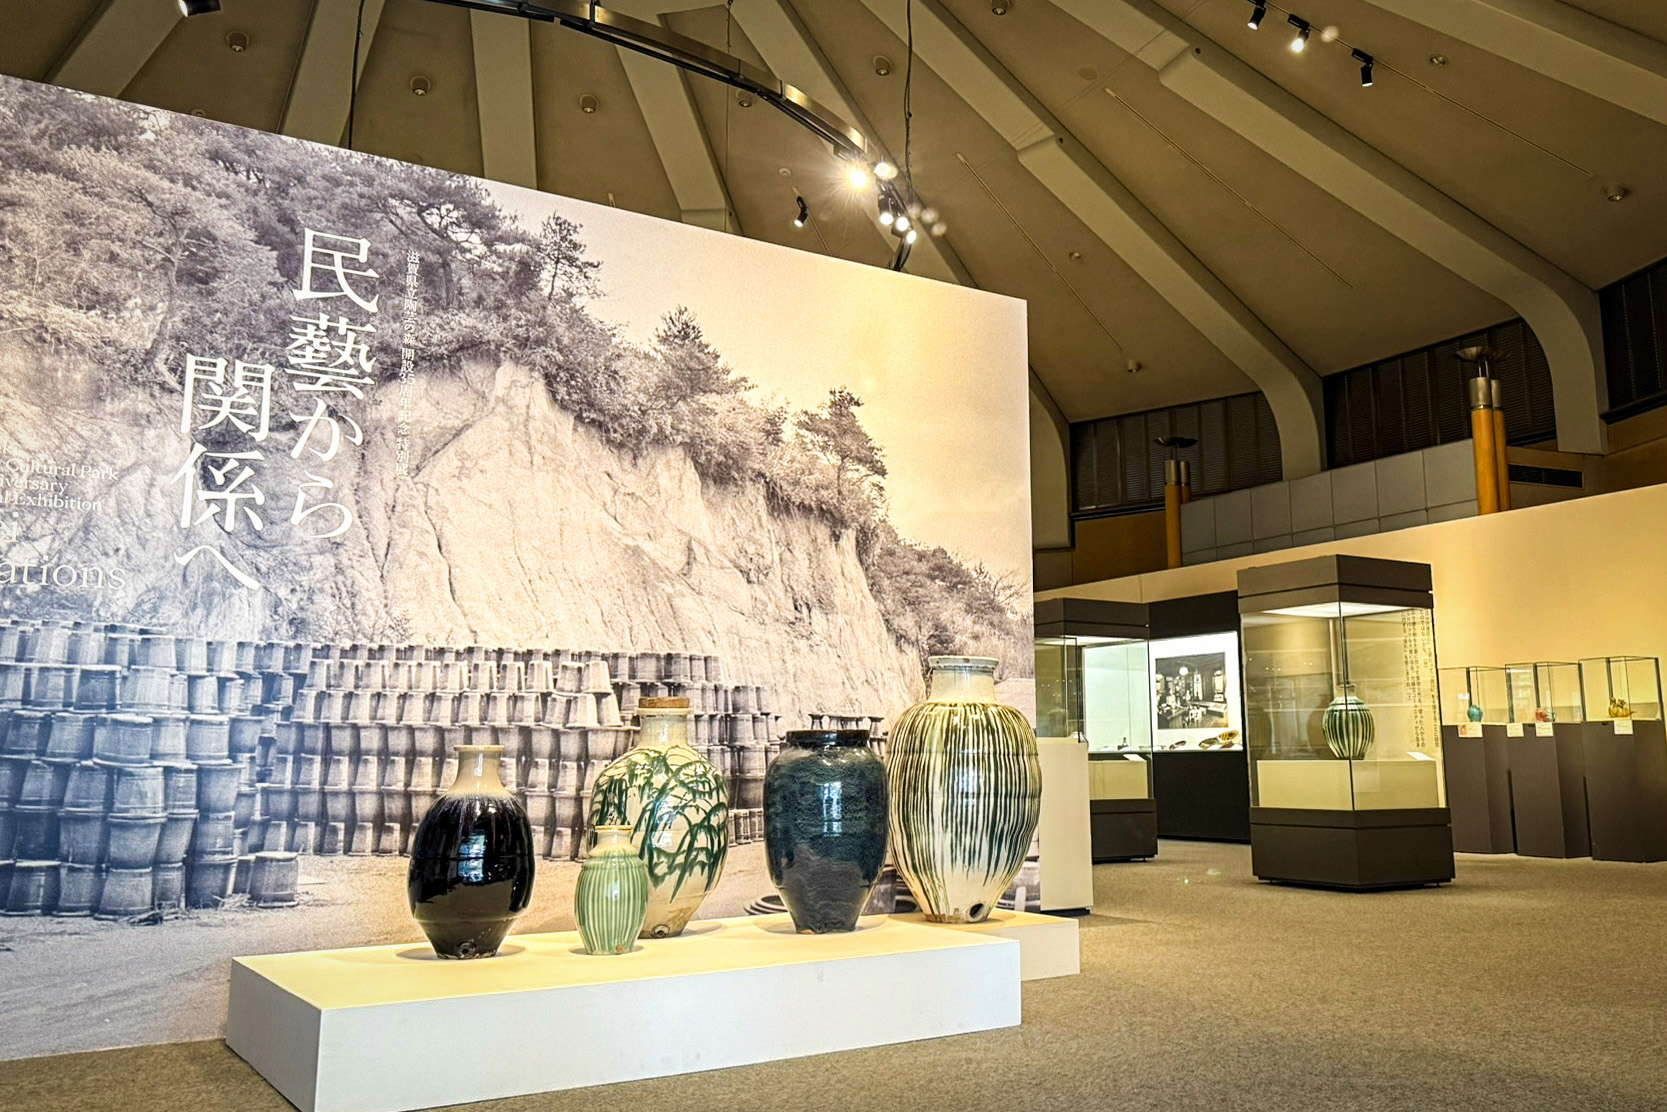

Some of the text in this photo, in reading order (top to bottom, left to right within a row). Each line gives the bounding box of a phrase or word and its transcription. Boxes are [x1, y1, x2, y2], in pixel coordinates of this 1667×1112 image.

[6, 459, 119, 481] Cultural Park
[169, 353, 275, 590] 関係へ
[284, 227, 380, 539] 民藝から
[395, 250, 420, 477] 滋賀県立陶芸の森 開設35周年記念 特別展
[13, 493, 102, 511] Exhibition
